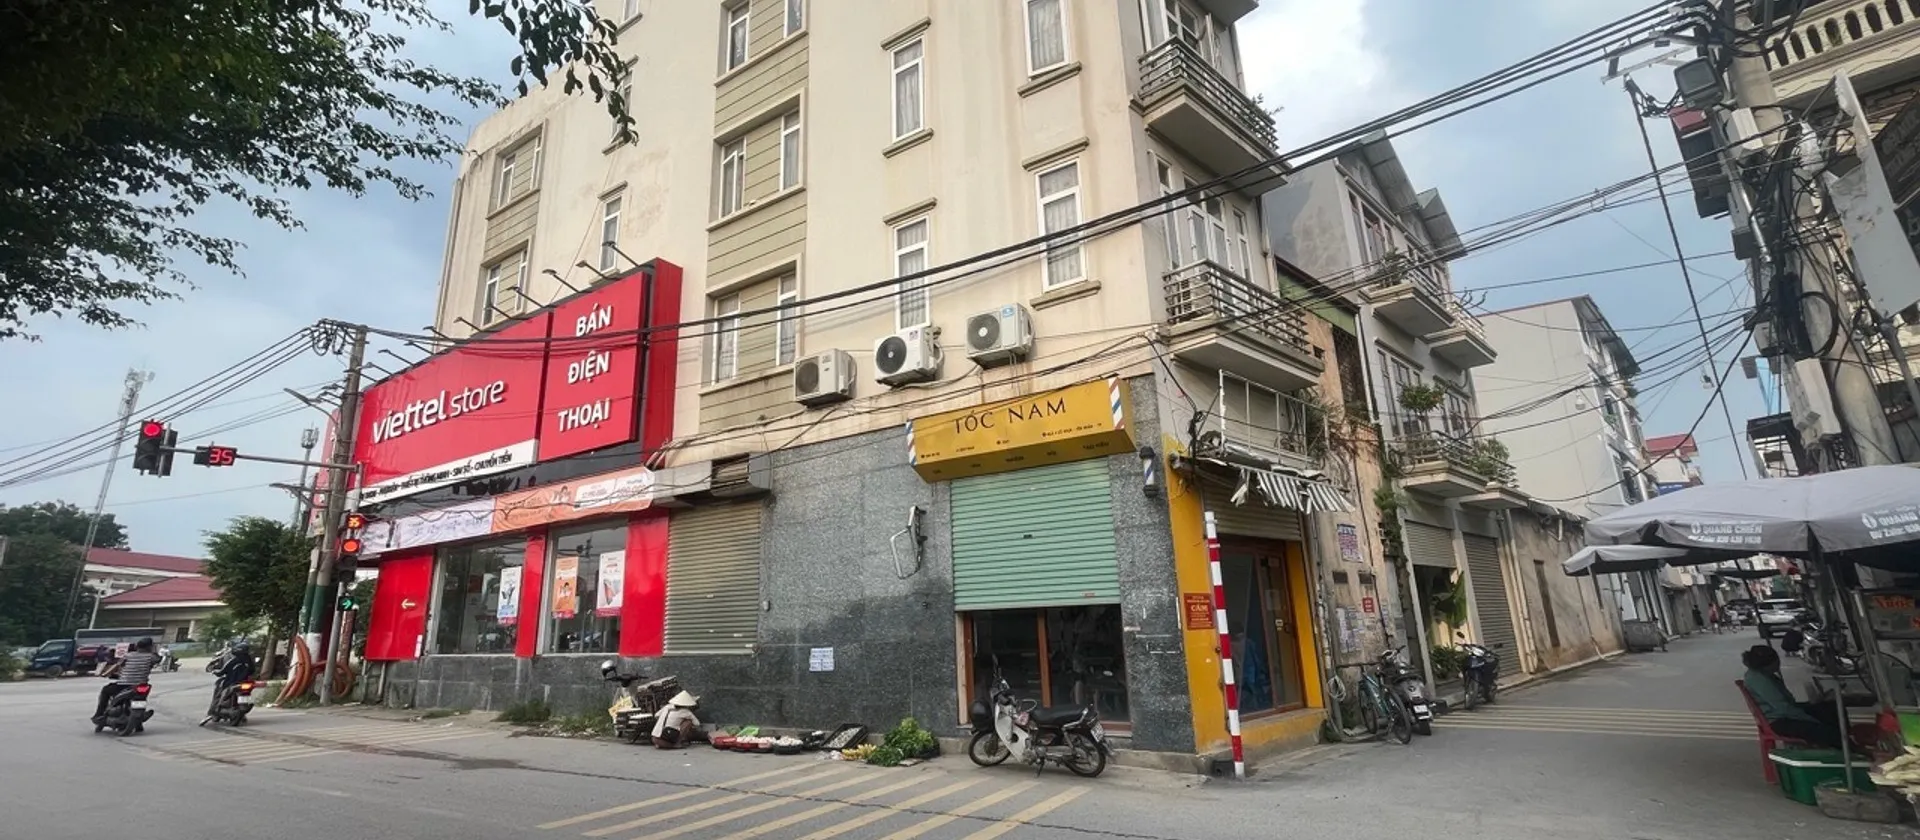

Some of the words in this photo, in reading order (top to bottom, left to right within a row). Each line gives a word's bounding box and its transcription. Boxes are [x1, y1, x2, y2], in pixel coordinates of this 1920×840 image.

[575, 303, 612, 337] BÁN
[567, 350, 610, 385] ĐIỆN
[373, 389, 447, 443] viettel
[450, 380, 505, 417] store
[557, 398, 610, 432] THOẠI
[954, 409, 995, 434] TÓC
[1008, 397, 1066, 423] NAM
[209, 448, 233, 465] 35
[1702, 524, 1733, 535] QUANG
